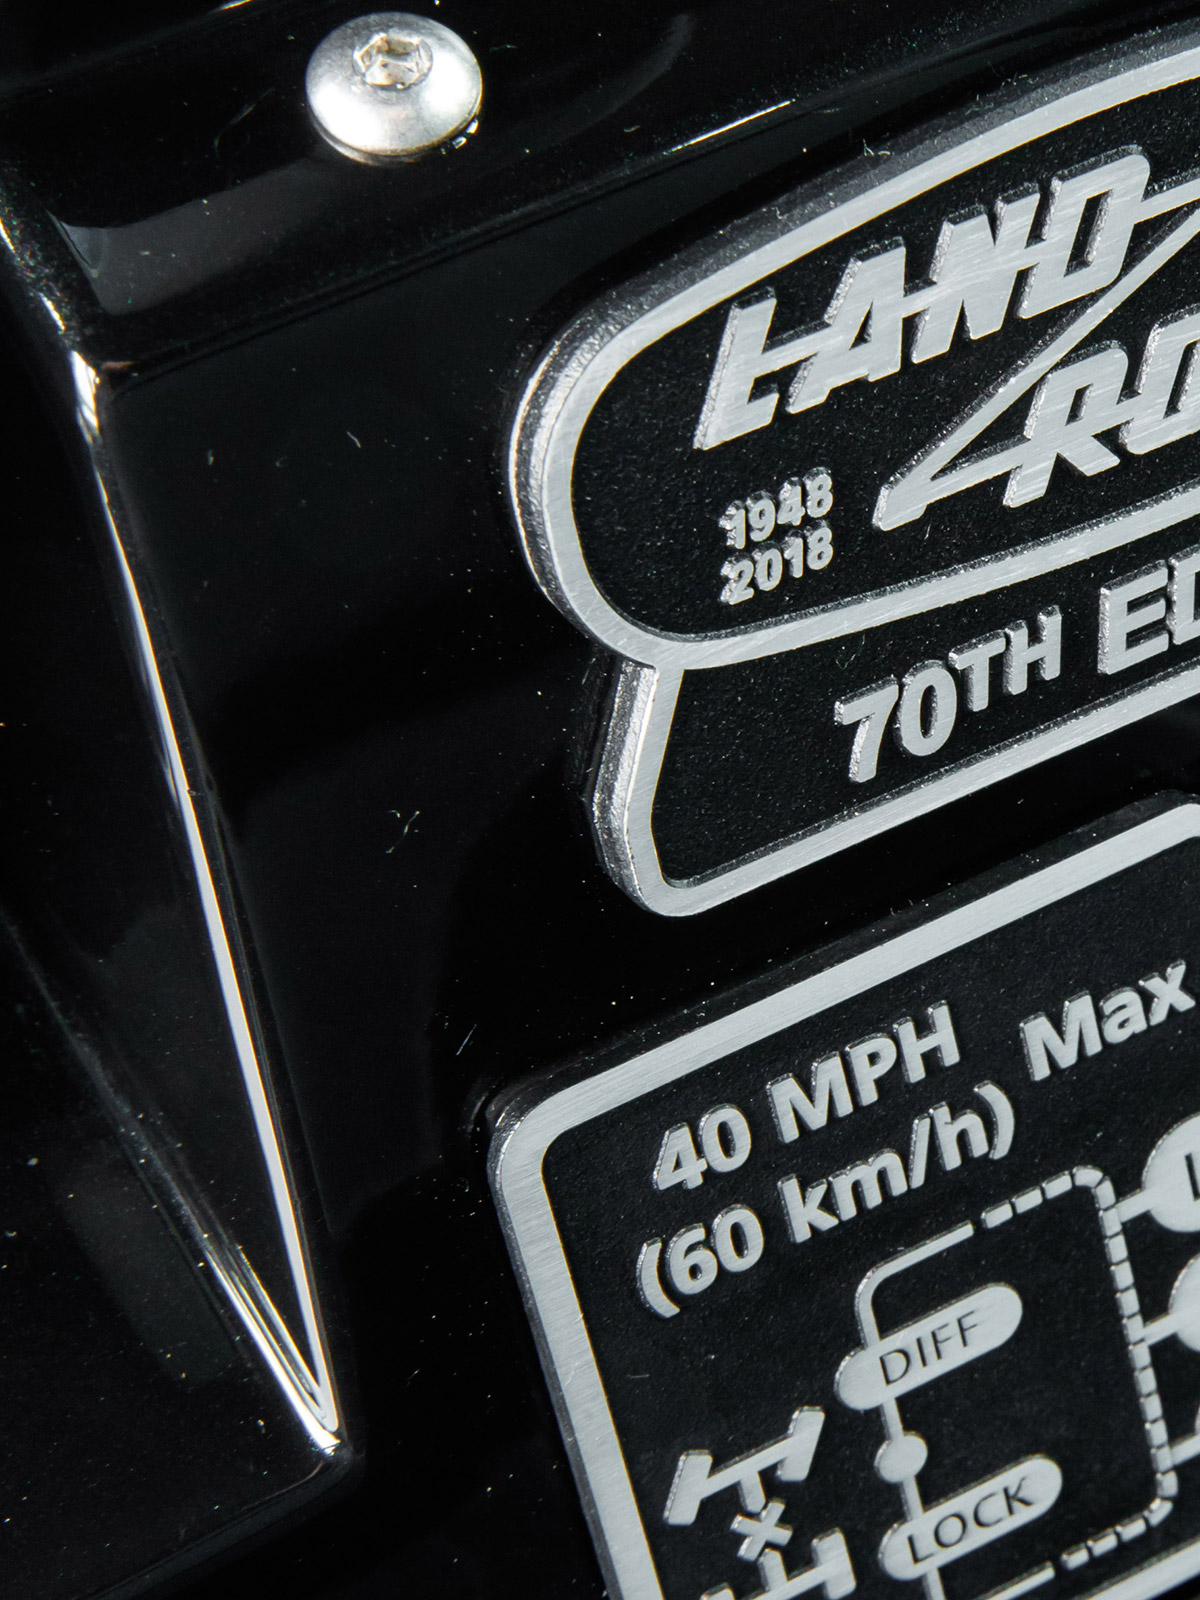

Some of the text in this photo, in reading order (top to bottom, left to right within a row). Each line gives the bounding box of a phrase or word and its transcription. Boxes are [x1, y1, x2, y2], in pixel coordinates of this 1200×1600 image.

[693, 145, 1150, 450] LAND
[719, 466, 834, 548] 1948
[720, 525, 834, 606] 2018
[834, 605, 1062, 784] 70TH
[652, 960, 1196, 1192] 40 MPH Max
[635, 1080, 1015, 1318] (60 km/h)
[878, 1307, 980, 1387] DIFF
[907, 1474, 1036, 1564] LOCK
